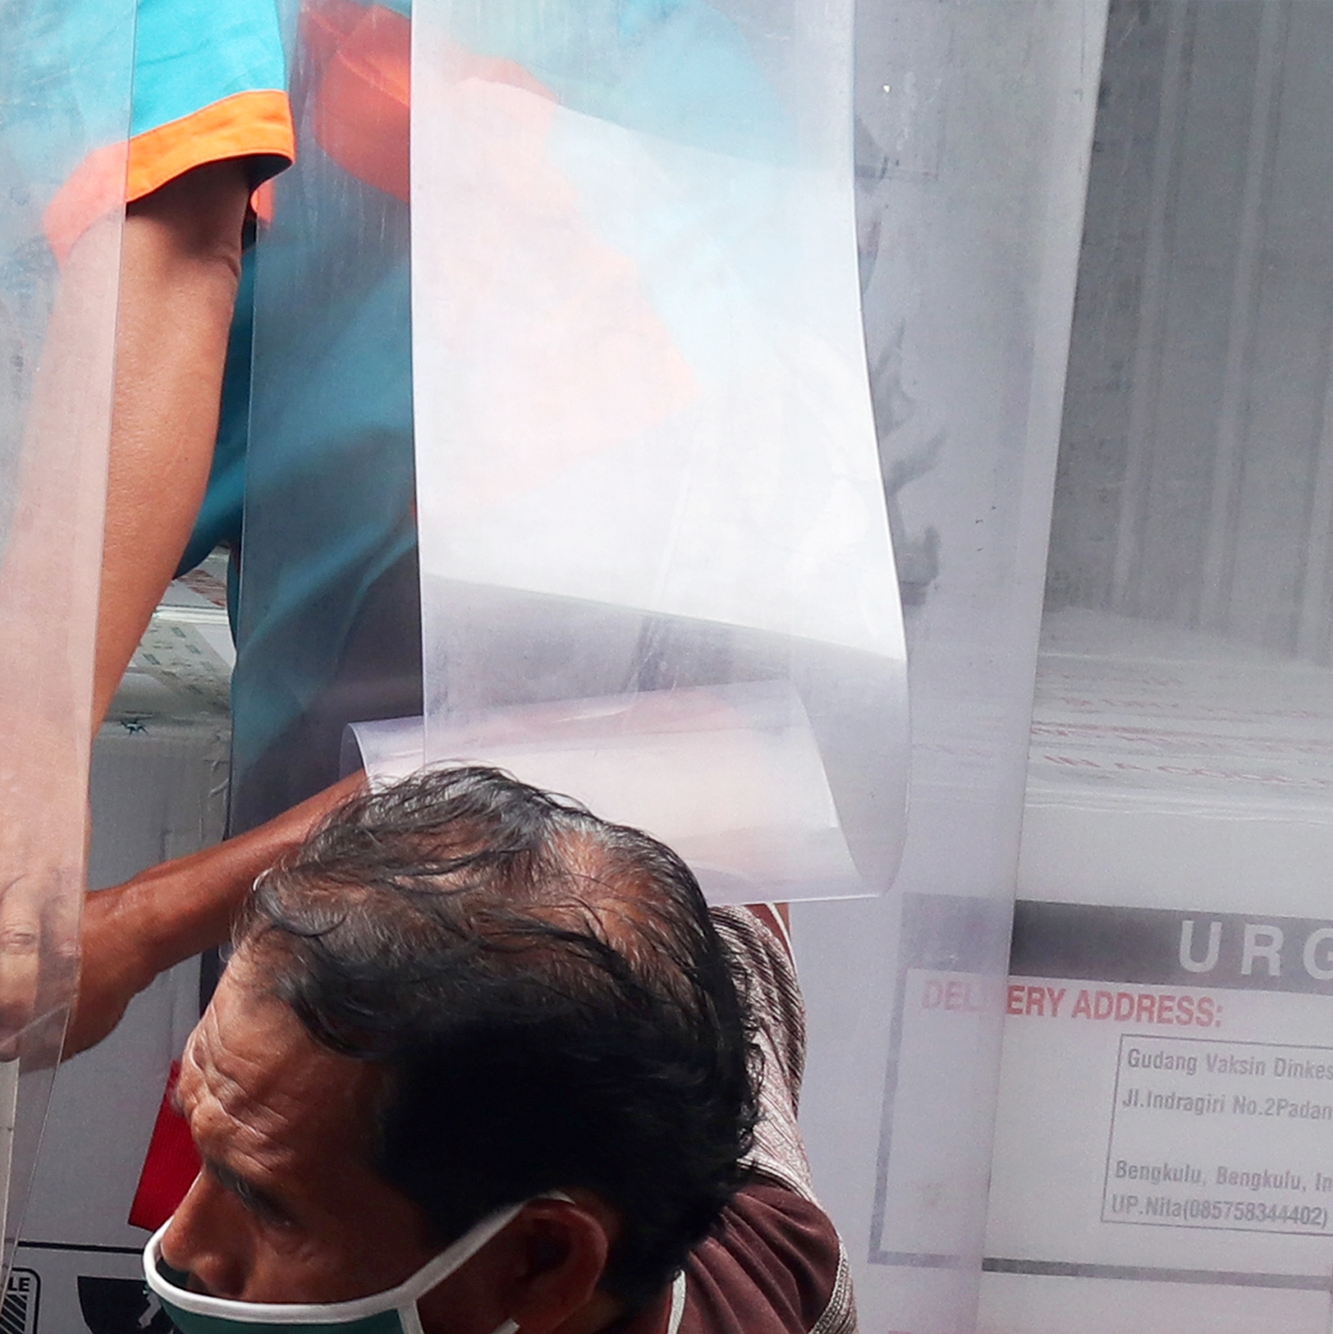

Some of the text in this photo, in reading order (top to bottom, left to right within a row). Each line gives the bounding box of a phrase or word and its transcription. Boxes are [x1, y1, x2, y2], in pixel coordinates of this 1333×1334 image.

[1178, 918, 1333, 982] URG
[1072, 989, 1225, 1028] ADDRESS:
[1126, 1048, 1198, 1076] Gudang
[1205, 1052, 1265, 1076] Vaksin
[1115, 1160, 1207, 1187] Bengkulu,
[1216, 1166, 1307, 1193] Bengkulu,
